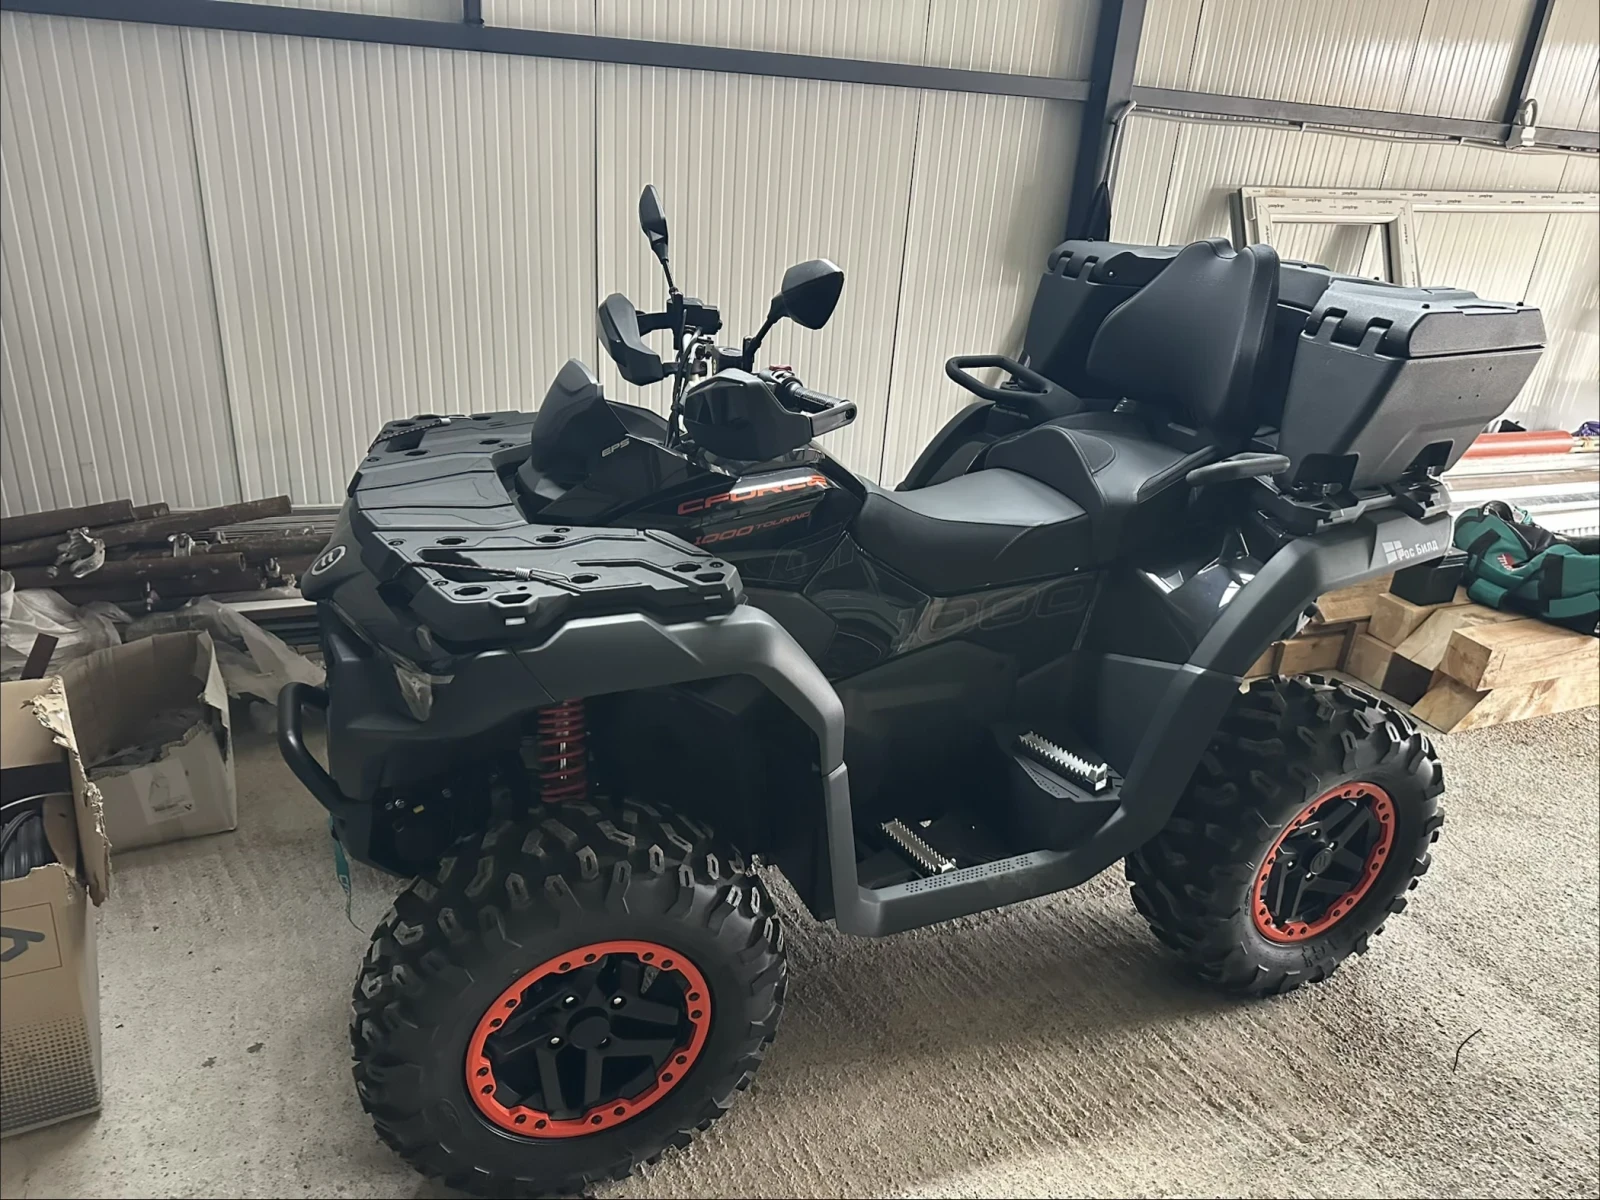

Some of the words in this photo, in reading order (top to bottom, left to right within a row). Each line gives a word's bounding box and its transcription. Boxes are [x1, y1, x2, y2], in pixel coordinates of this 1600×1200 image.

[601, 437, 630, 457] EPS
[693, 525, 755, 546] 1000
[755, 511, 812, 530] TOURING
[1415, 540, 1439, 556] Билд
